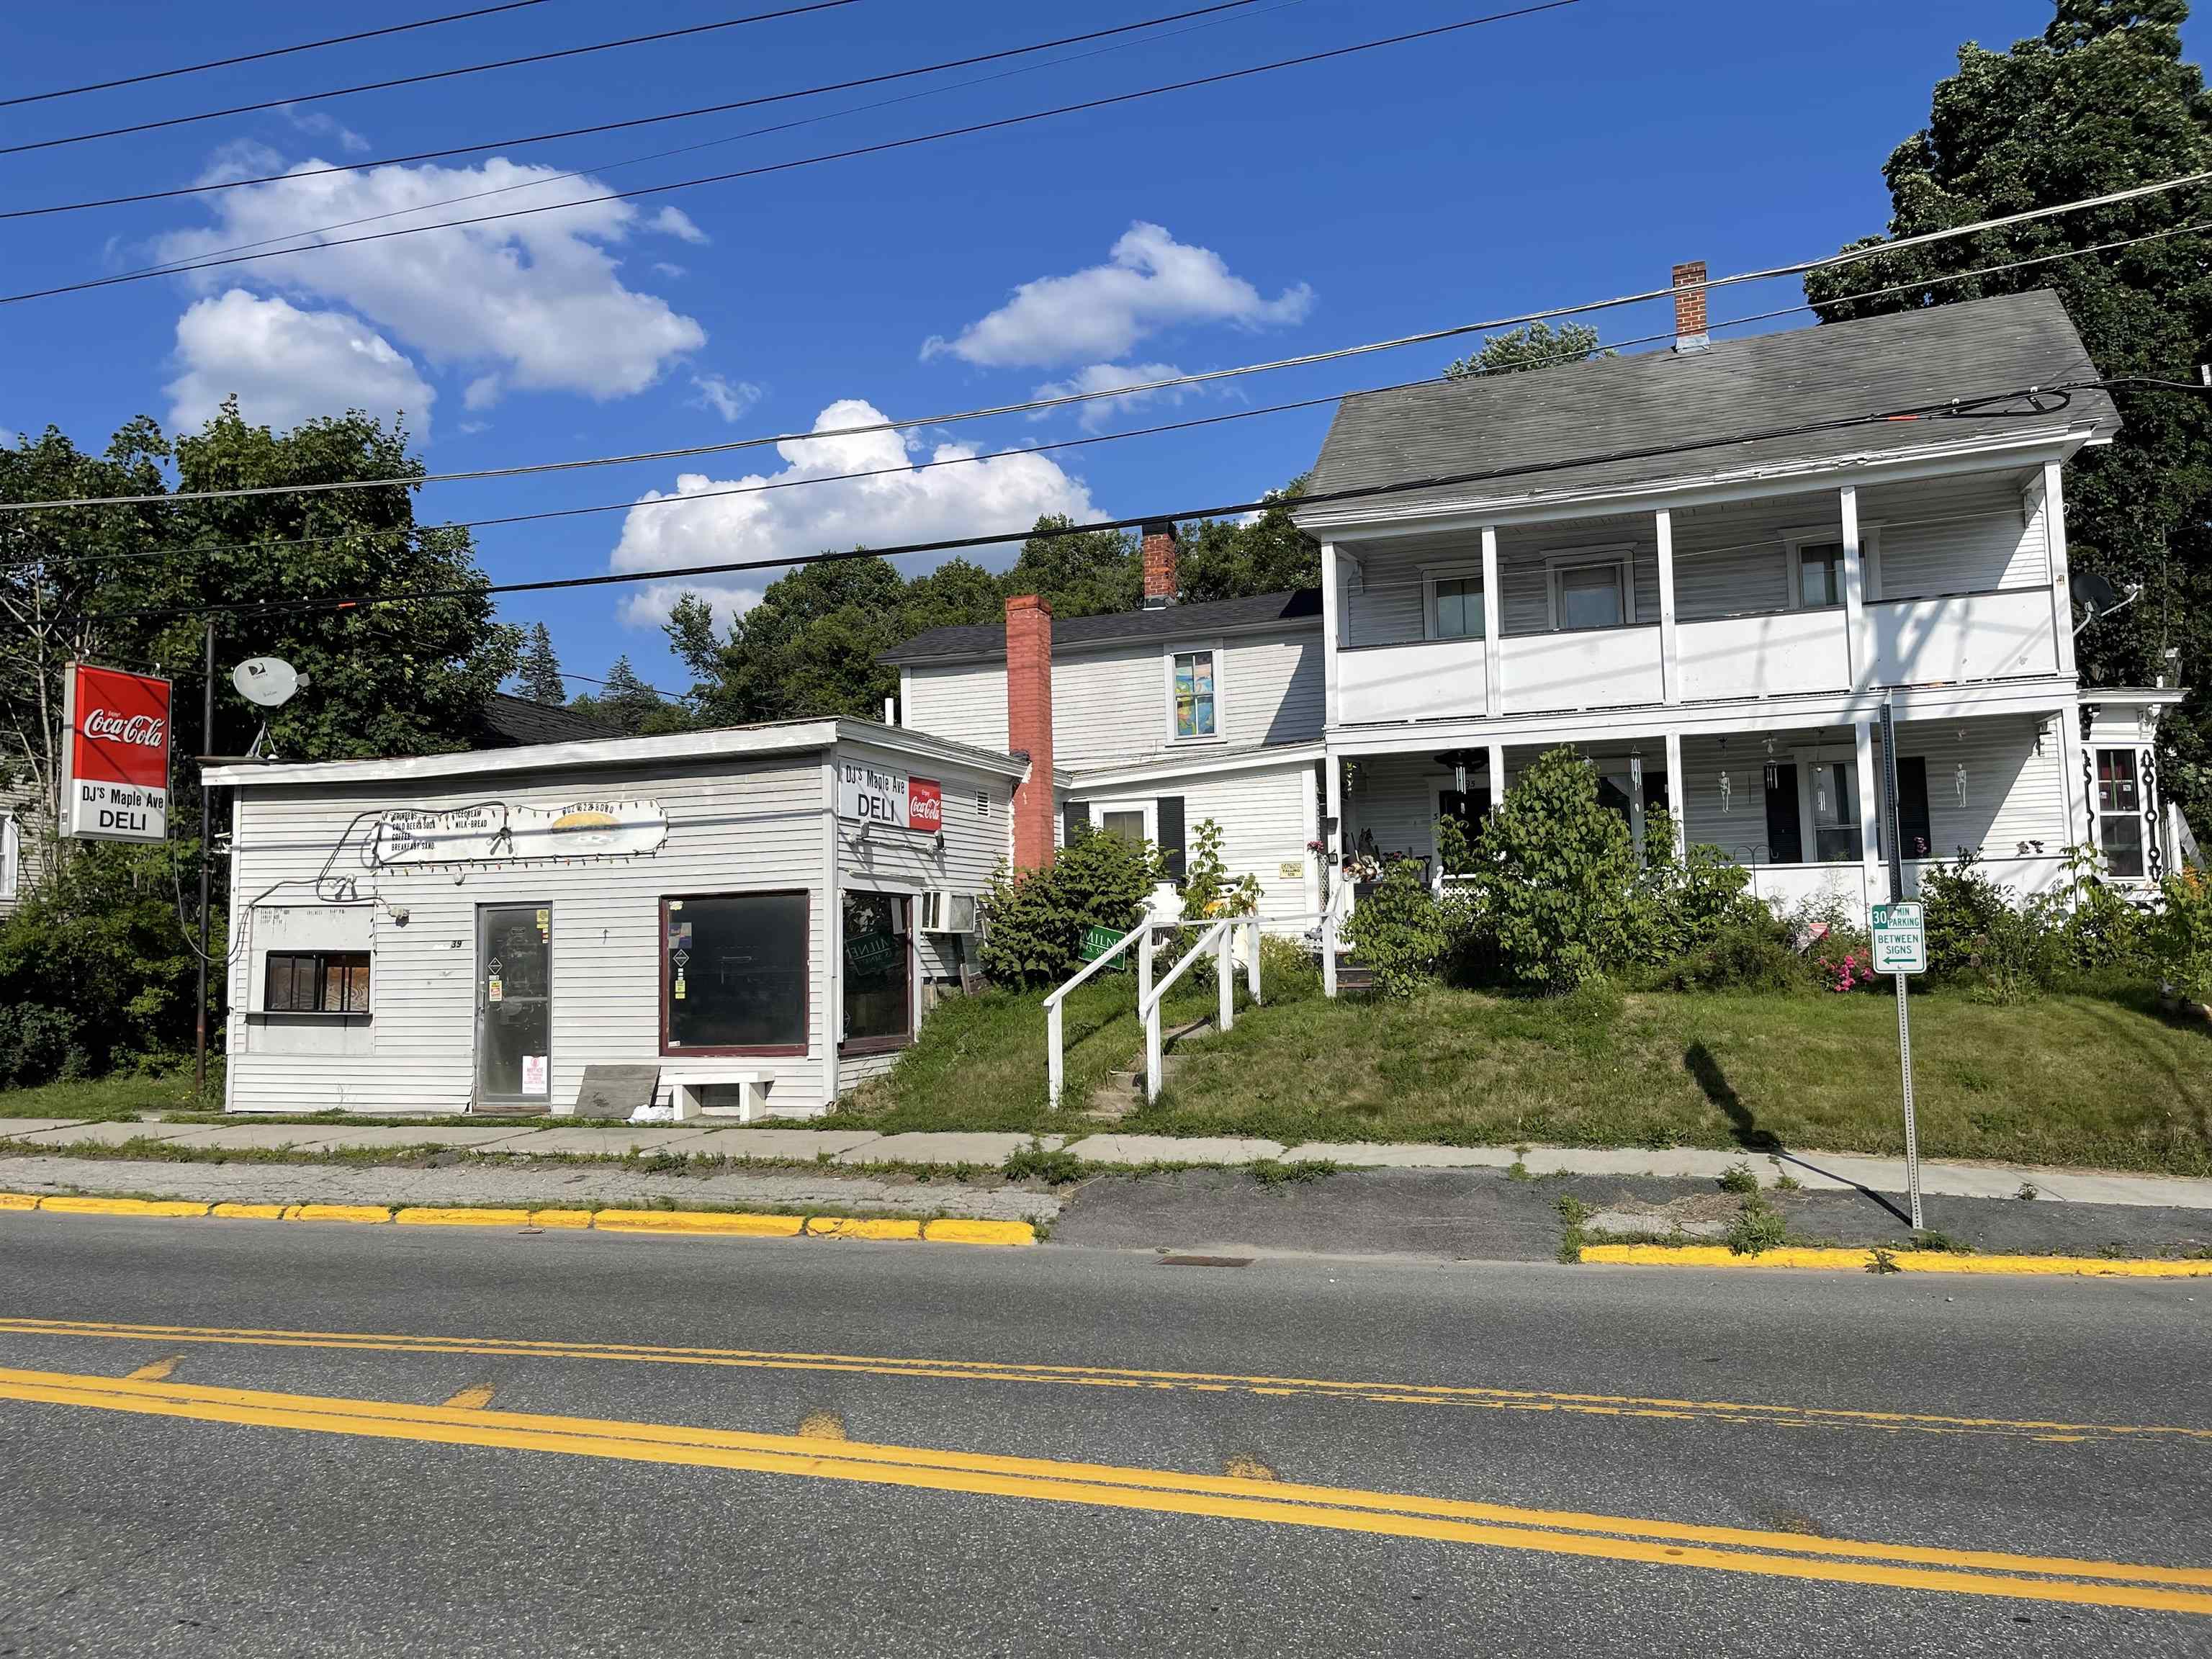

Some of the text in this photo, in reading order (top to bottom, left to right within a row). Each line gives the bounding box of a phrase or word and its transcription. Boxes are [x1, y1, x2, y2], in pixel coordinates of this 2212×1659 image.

[84, 709, 165, 747] Coca-Cola
[866, 769, 889, 792] Maple
[892, 775, 905, 794] Ave
[110, 788, 142, 808] Maple
[146, 793, 163, 809] Ave
[858, 793, 894, 822] DELI
[99, 809, 146, 831] DELI
[392, 832, 411, 841] COFFEE
[391, 842, 419, 851] BREAKFAST
[1873, 910, 1887, 924] 30
[1889, 917, 1920, 927] PARKING
[451, 940, 462, 948] 39
[1082, 930, 1120, 948] MILN
[1878, 935, 1919, 943] BETWEEN
[1886, 945, 1912, 954] SIGNS
